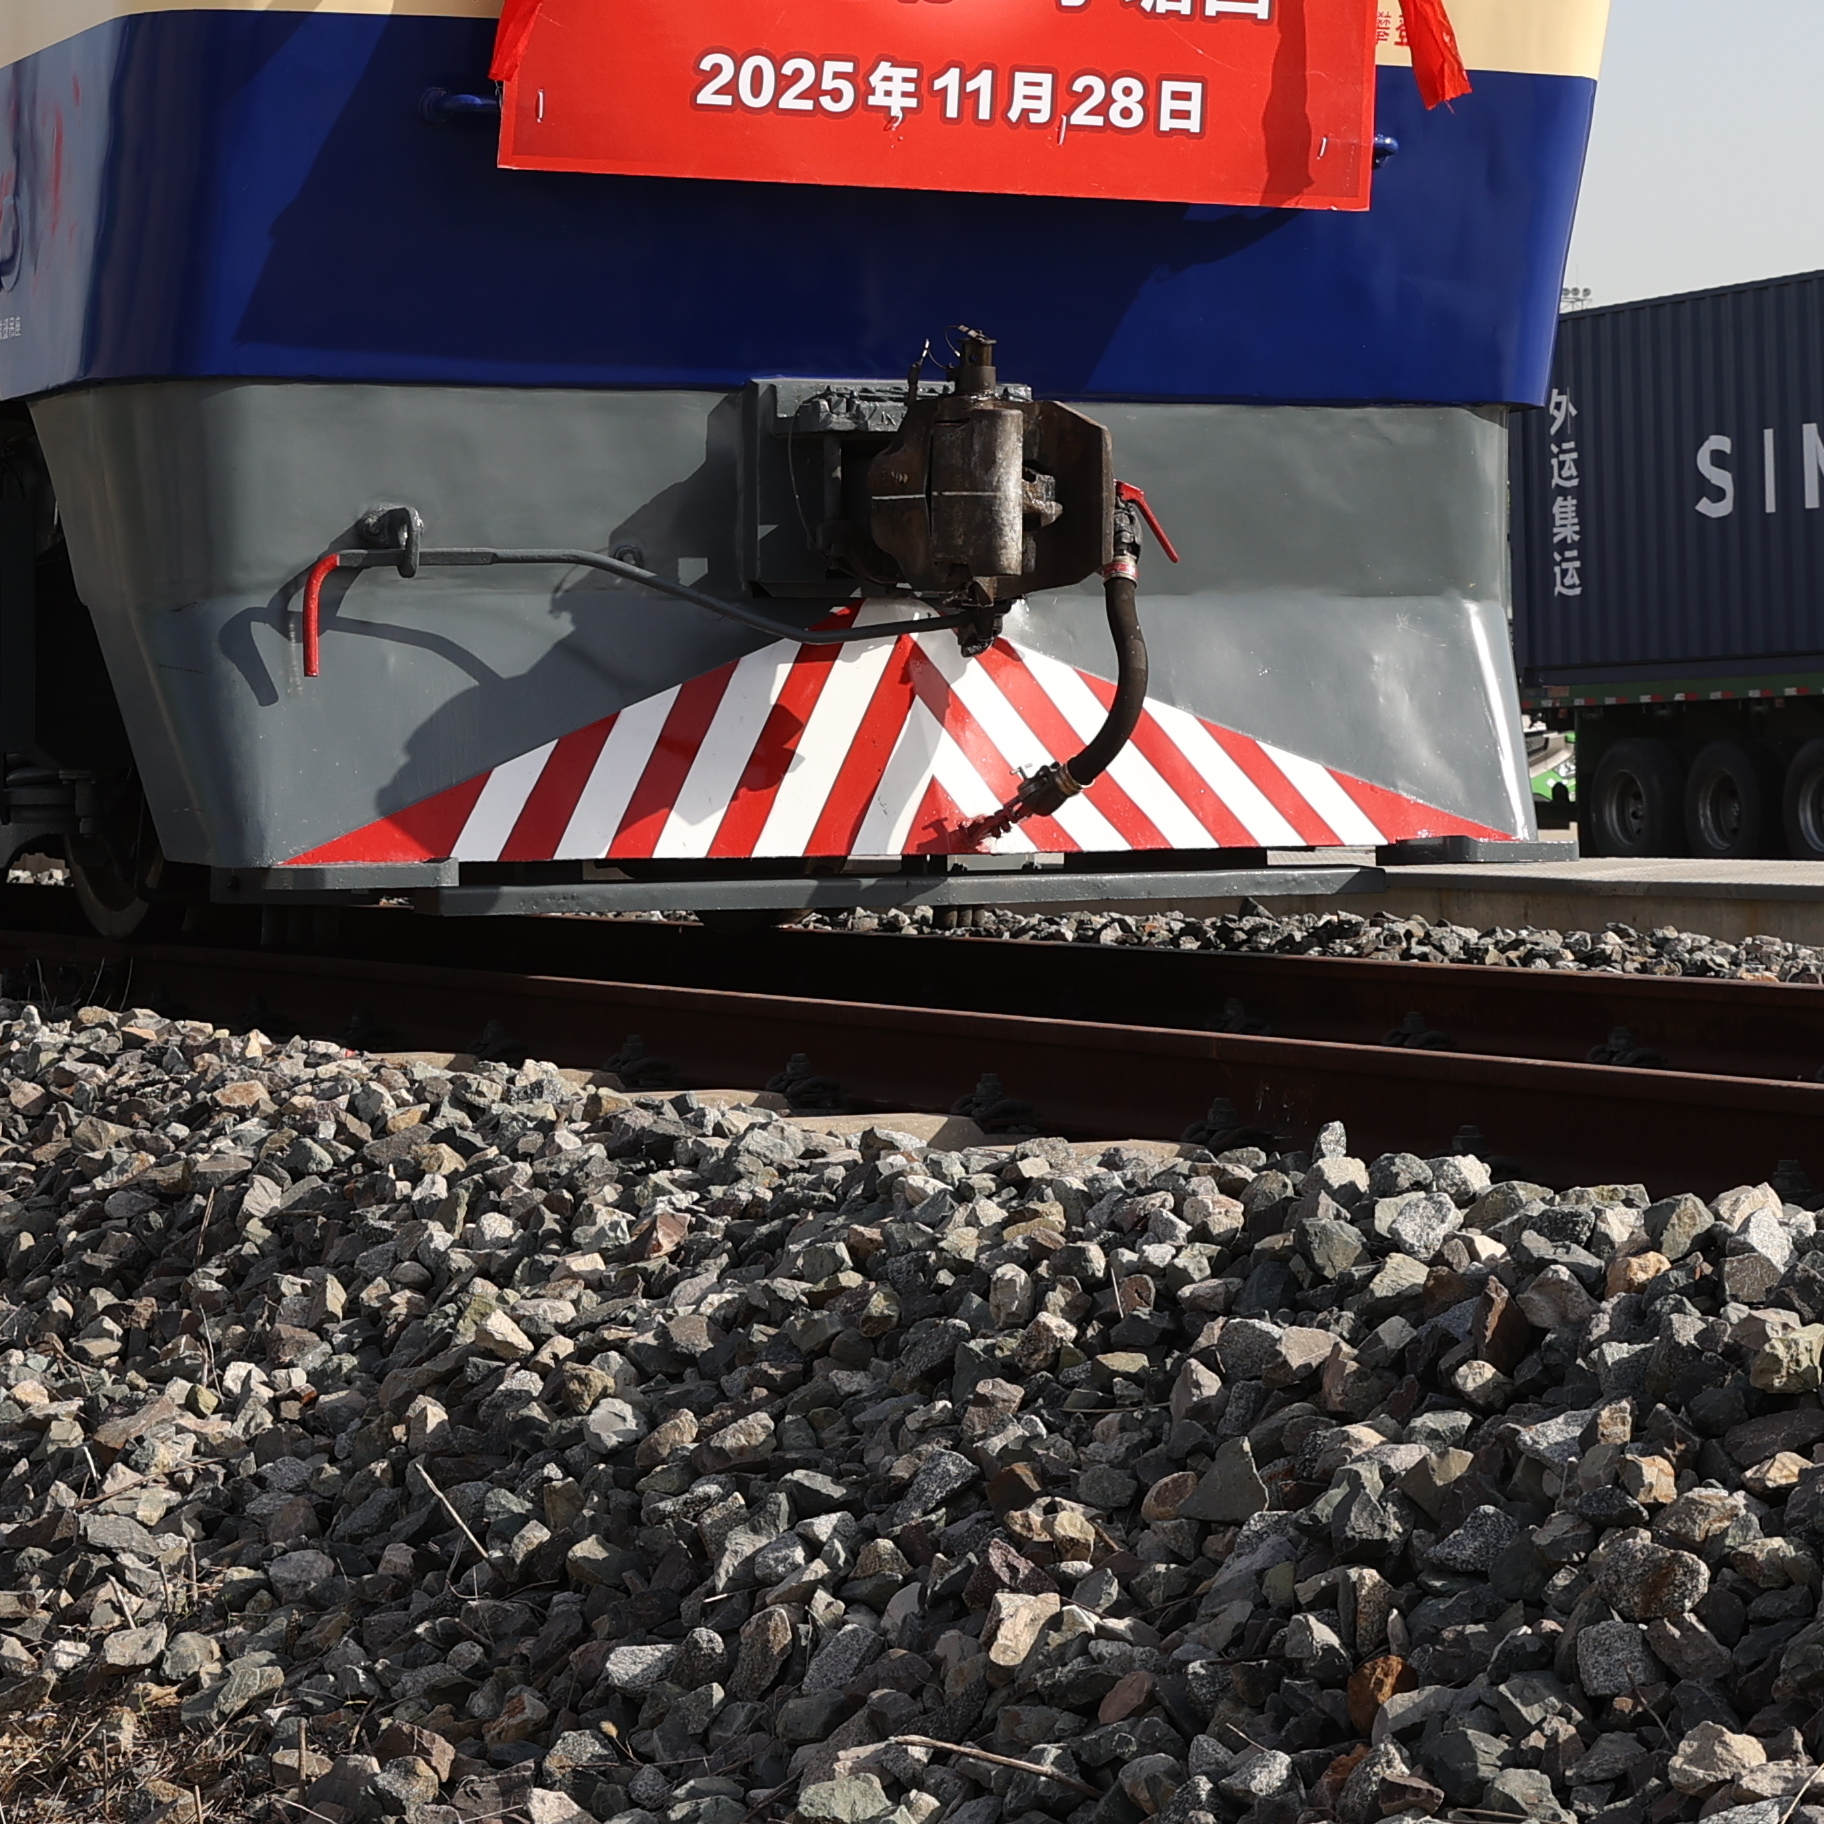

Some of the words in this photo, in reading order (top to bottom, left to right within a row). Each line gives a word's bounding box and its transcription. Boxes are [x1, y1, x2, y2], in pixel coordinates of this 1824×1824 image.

[695, 52, 1206, 136] 2025年11月28日
[1549, 387, 1583, 597] 外运集运
